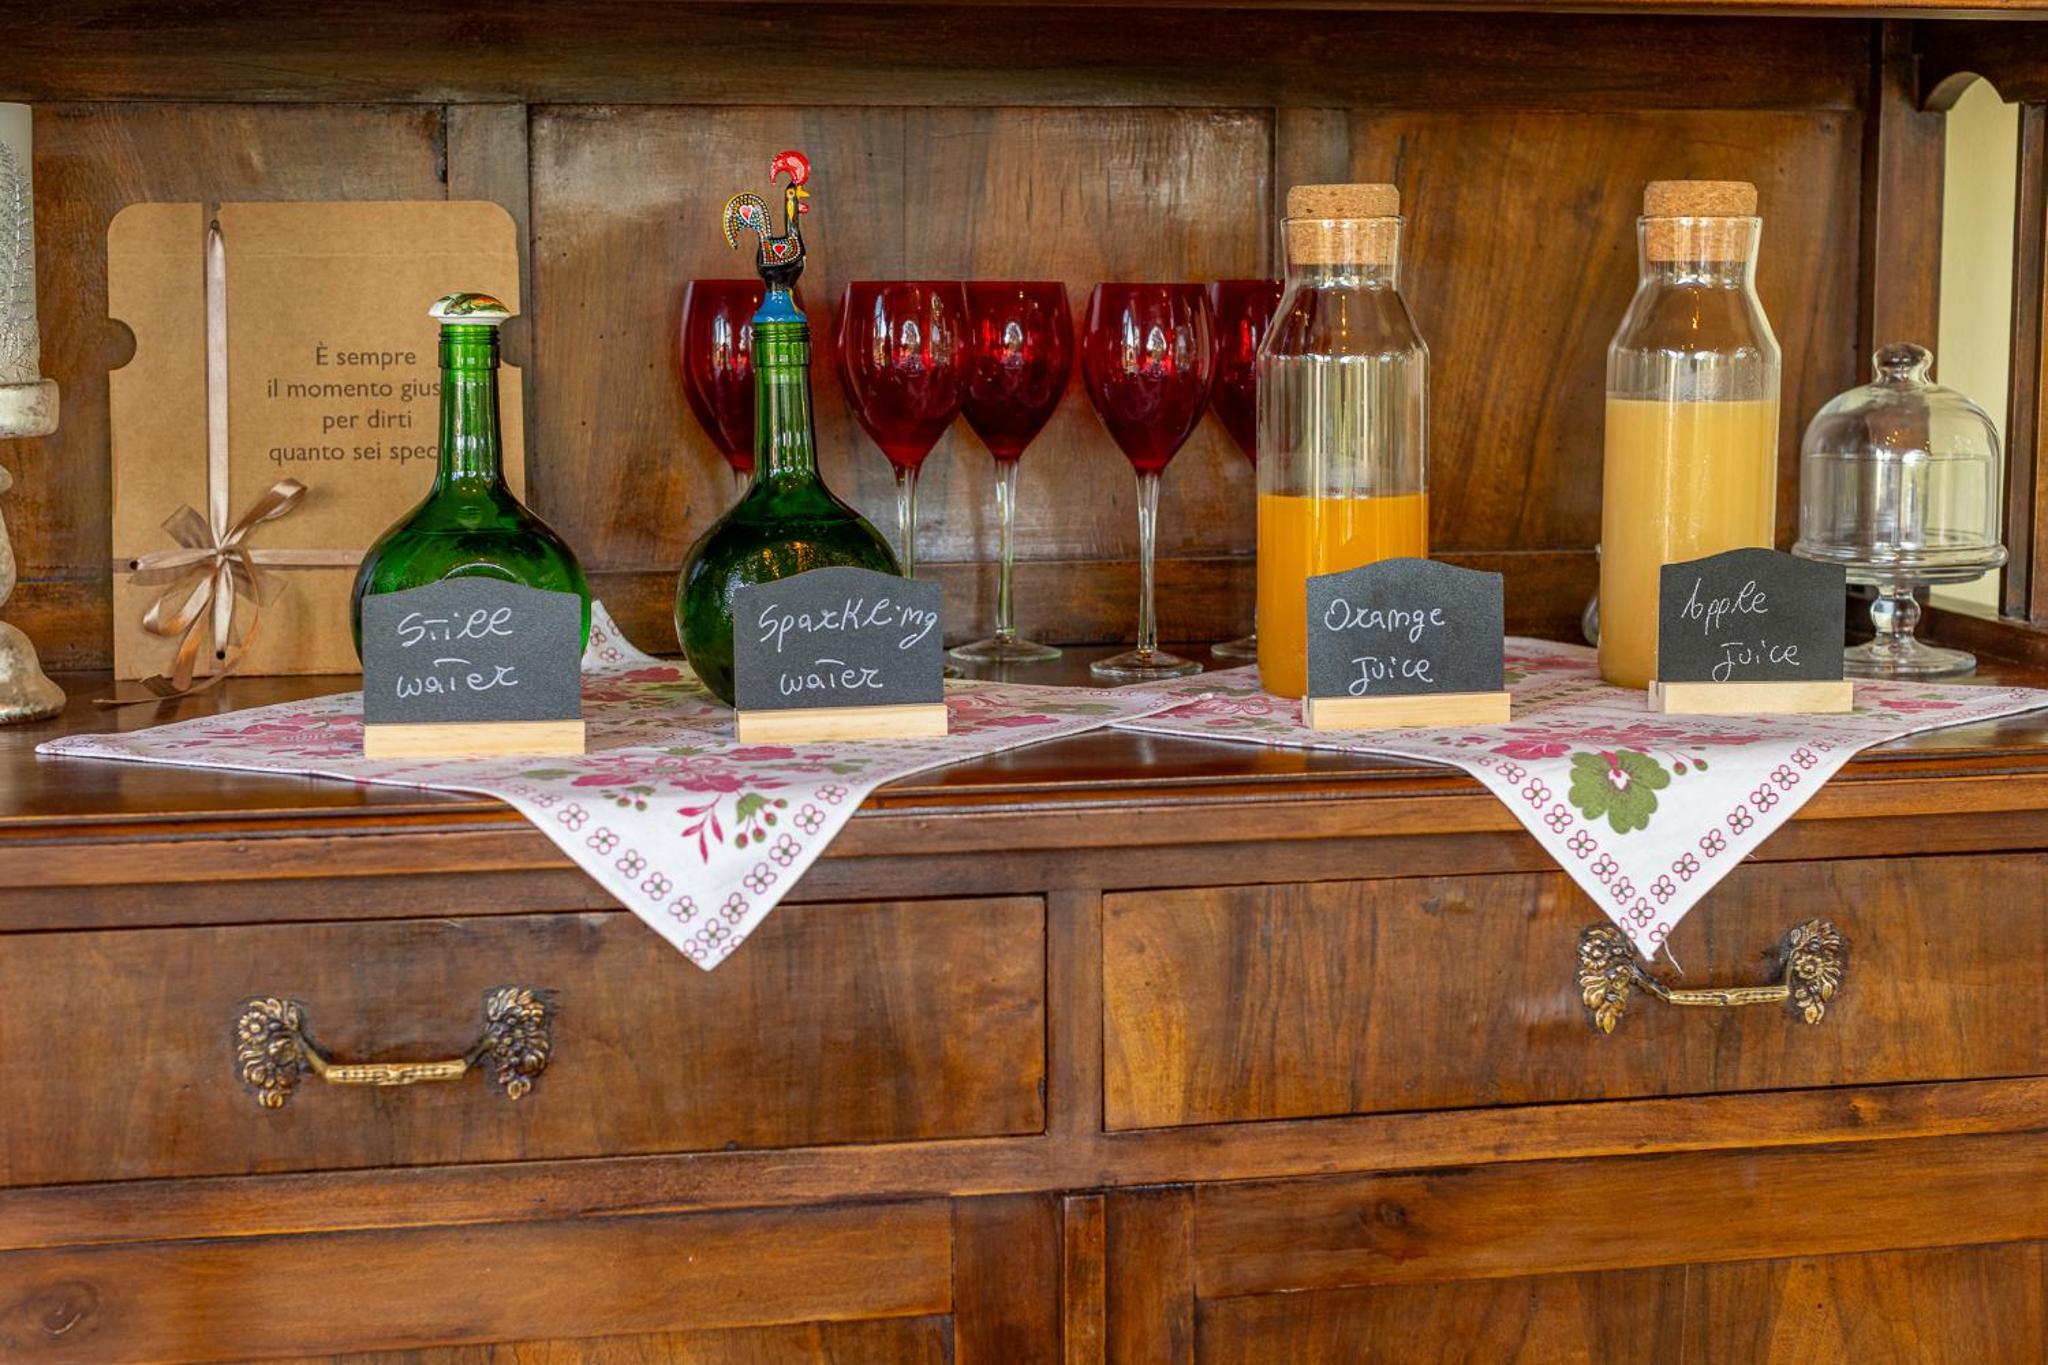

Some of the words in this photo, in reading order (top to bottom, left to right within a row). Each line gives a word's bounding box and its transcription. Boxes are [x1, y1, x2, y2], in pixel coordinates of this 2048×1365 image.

[315, 341, 329, 366] È
[336, 350, 417, 370] sempre
[267, 379, 278, 398] il
[287, 382, 393, 398] momento
[400, 378, 441, 402] gius
[322, 413, 358, 434] per
[367, 410, 412, 428] dirti
[269, 444, 345, 466] quanto
[353, 442, 381, 460] sei
[389, 445, 437, 465] spec
[397, 607, 513, 647] Still
[1324, 598, 1446, 643] Orange
[396, 658, 519, 698] water
[779, 658, 884, 696] water
